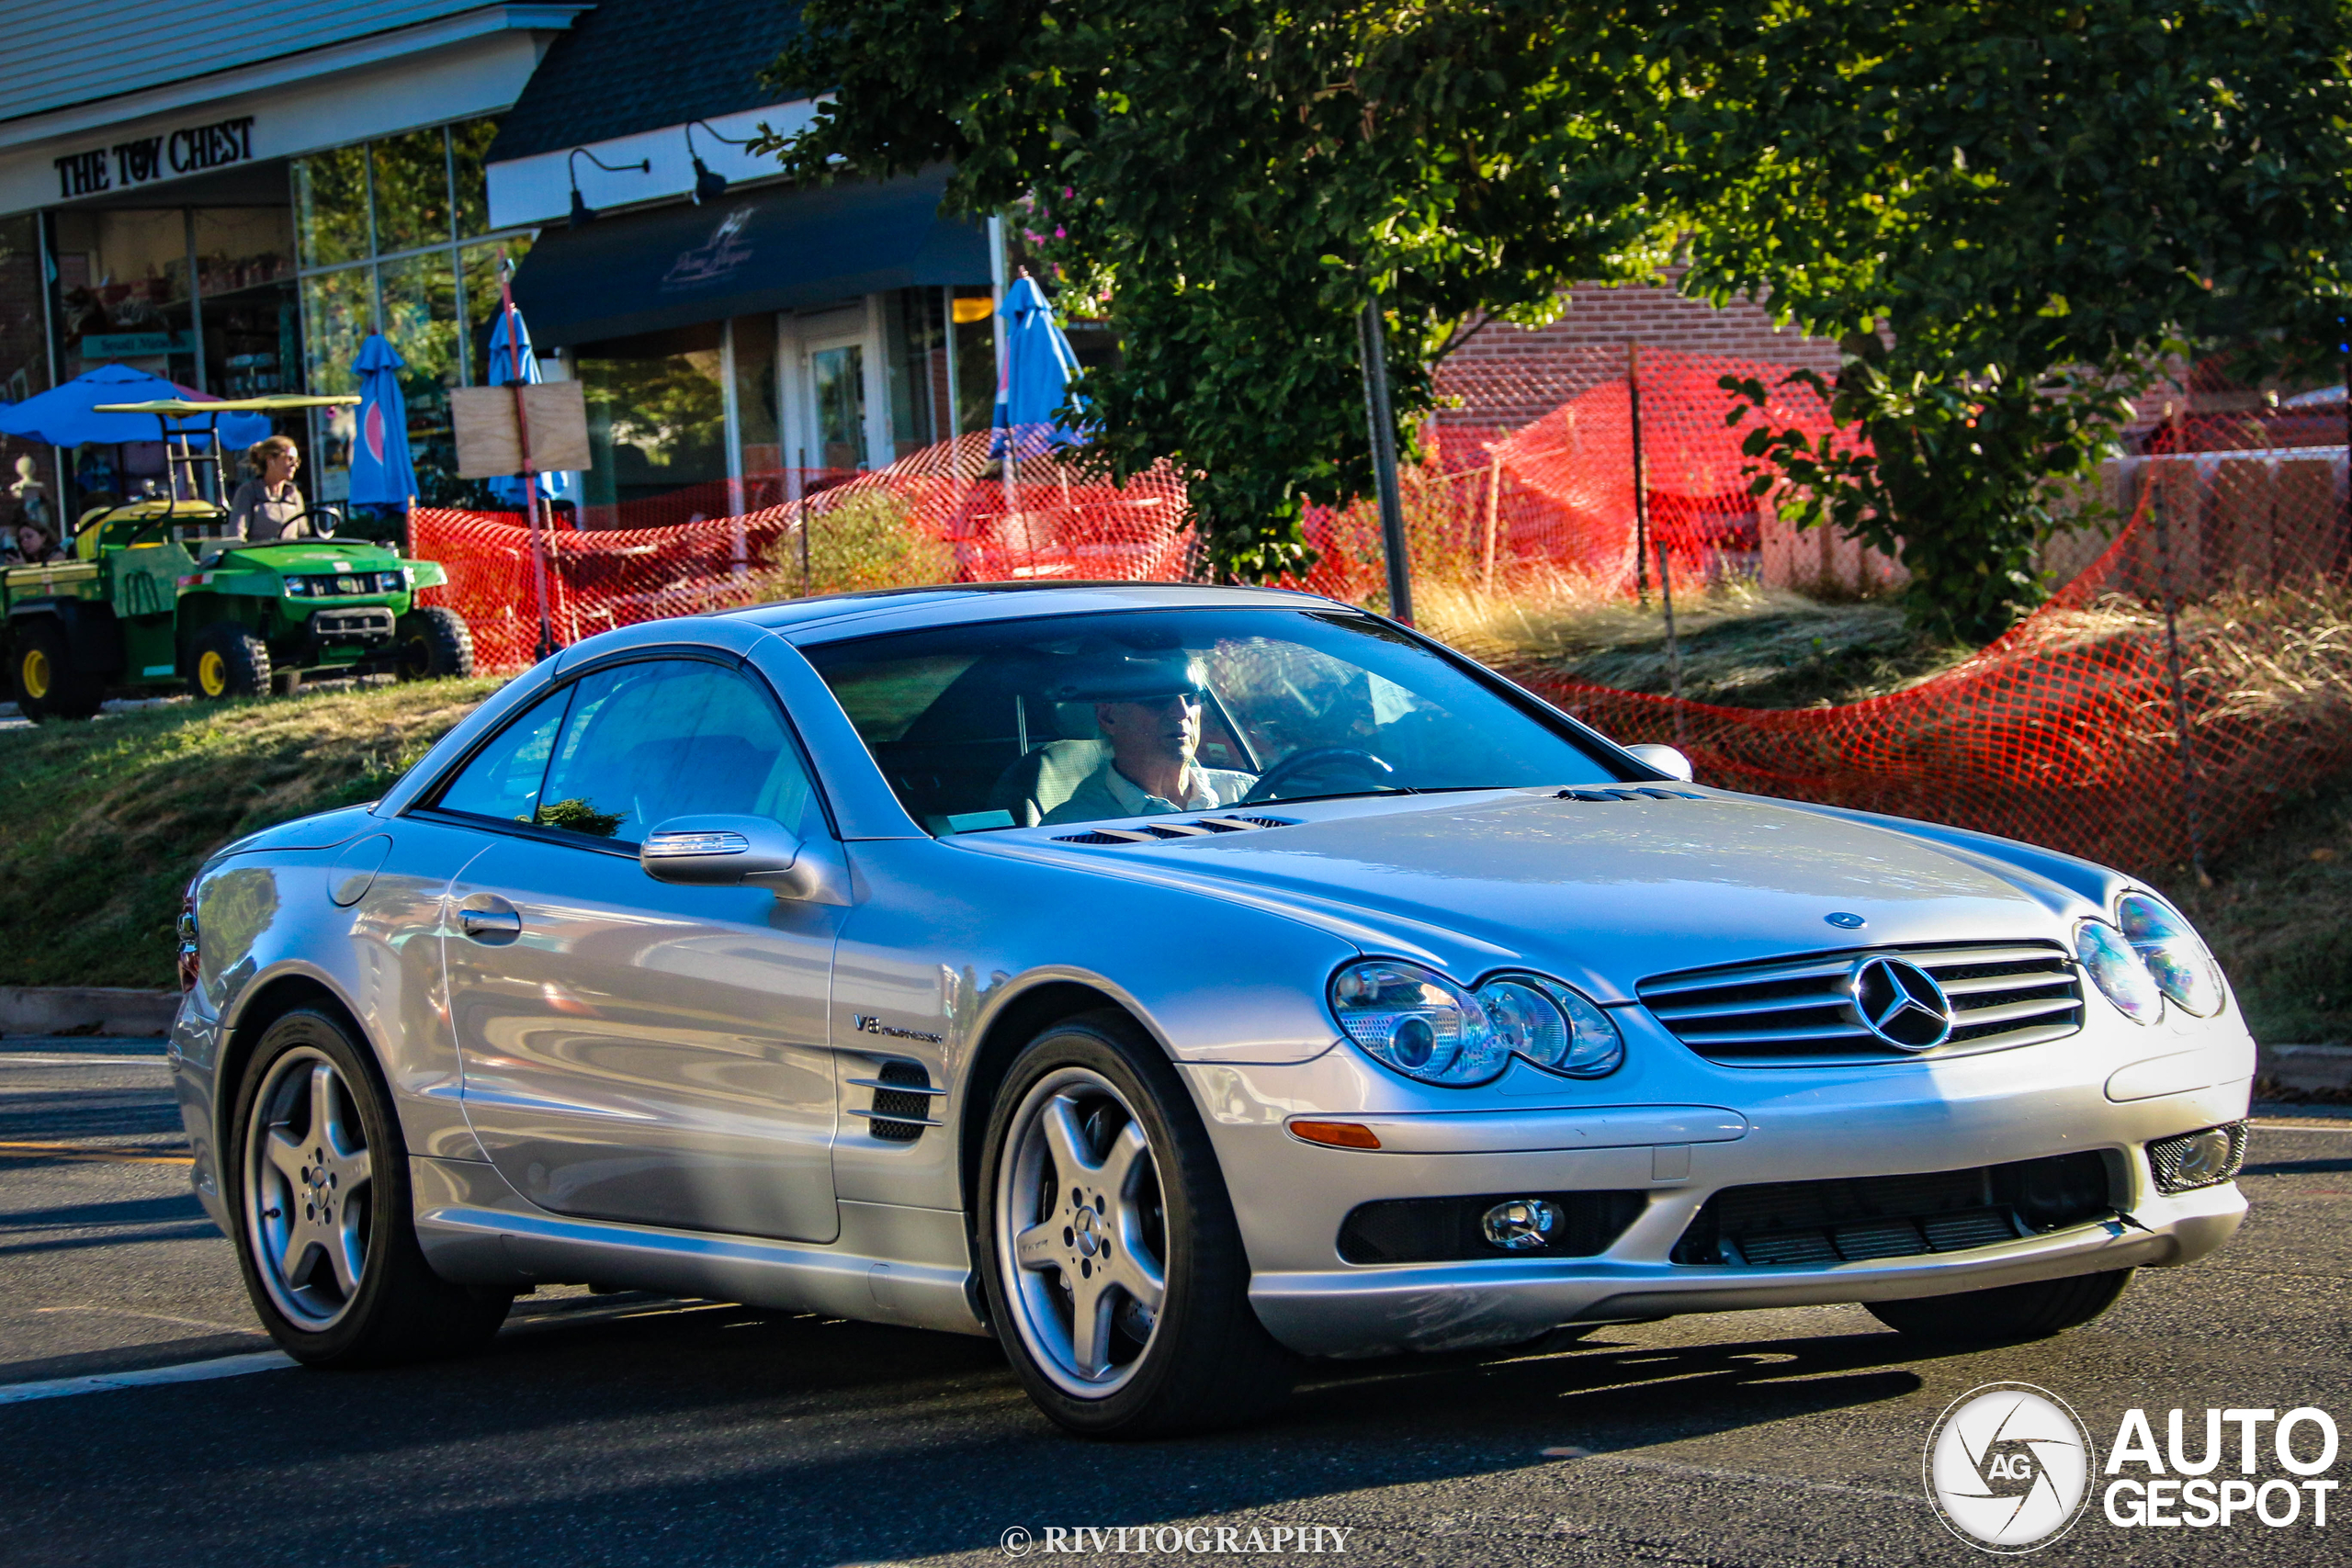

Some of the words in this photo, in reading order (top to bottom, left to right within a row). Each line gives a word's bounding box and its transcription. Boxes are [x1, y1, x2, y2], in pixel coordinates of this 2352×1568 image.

[54, 149, 110, 198] THE
[112, 135, 164, 186] TOY
[168, 115, 254, 174] CHEST
[854, 1013, 881, 1033] V8
